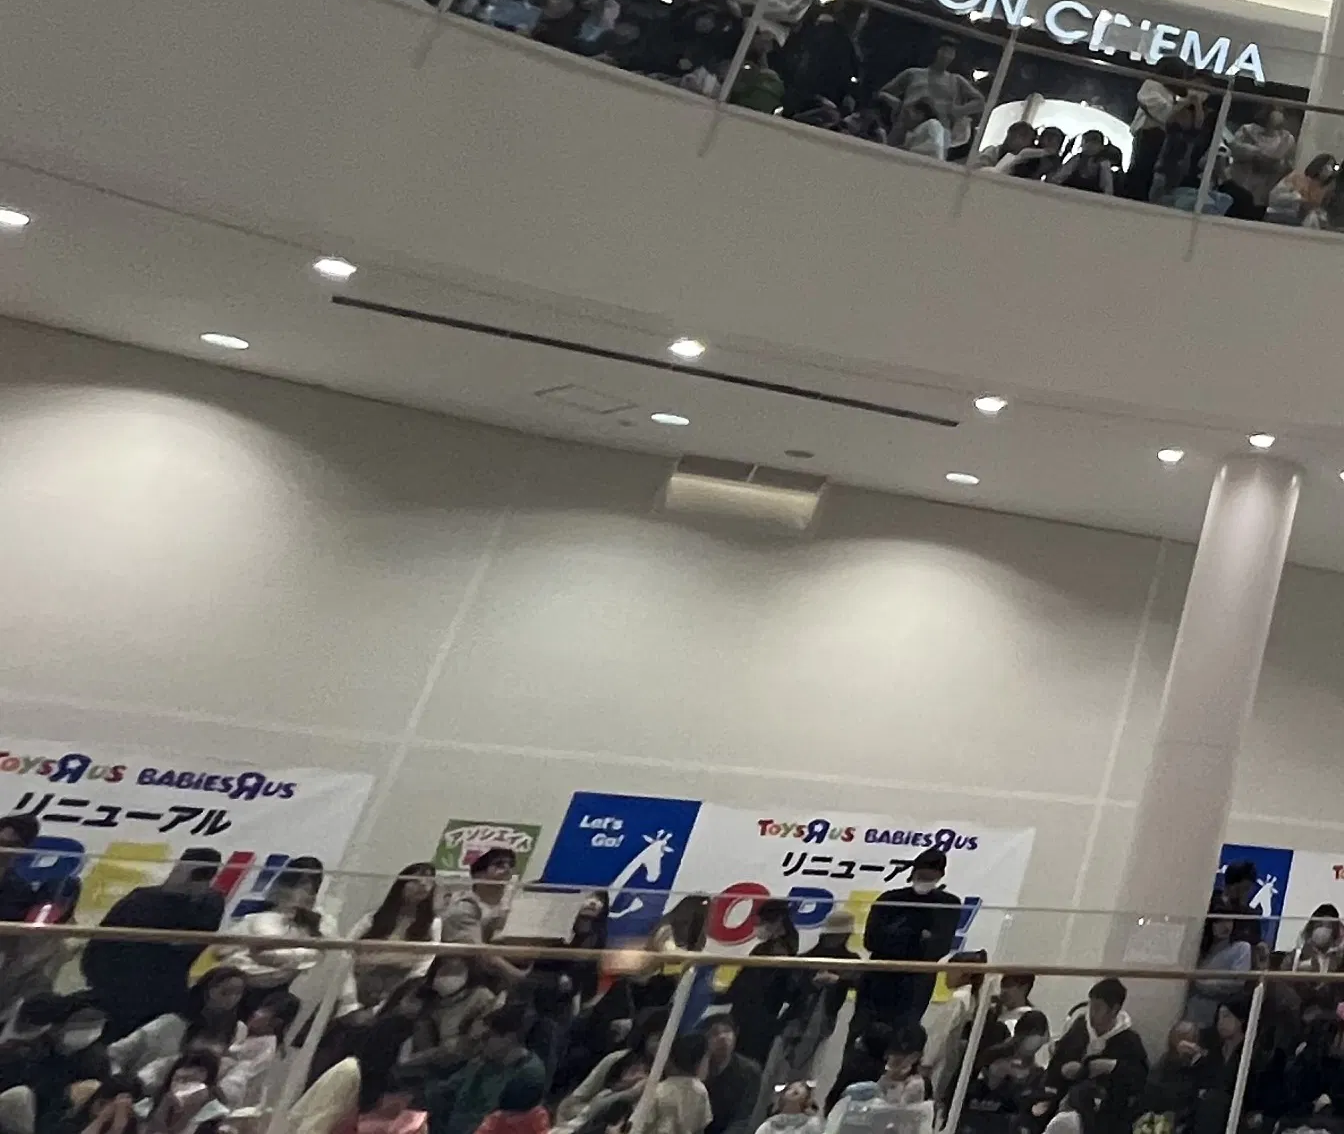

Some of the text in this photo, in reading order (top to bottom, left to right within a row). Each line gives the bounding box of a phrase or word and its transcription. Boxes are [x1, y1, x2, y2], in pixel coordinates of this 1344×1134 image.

[13, 792, 232, 836] リニューアル
[591, 833, 625, 848] Go!
[782, 852, 946, 889] リニューア
